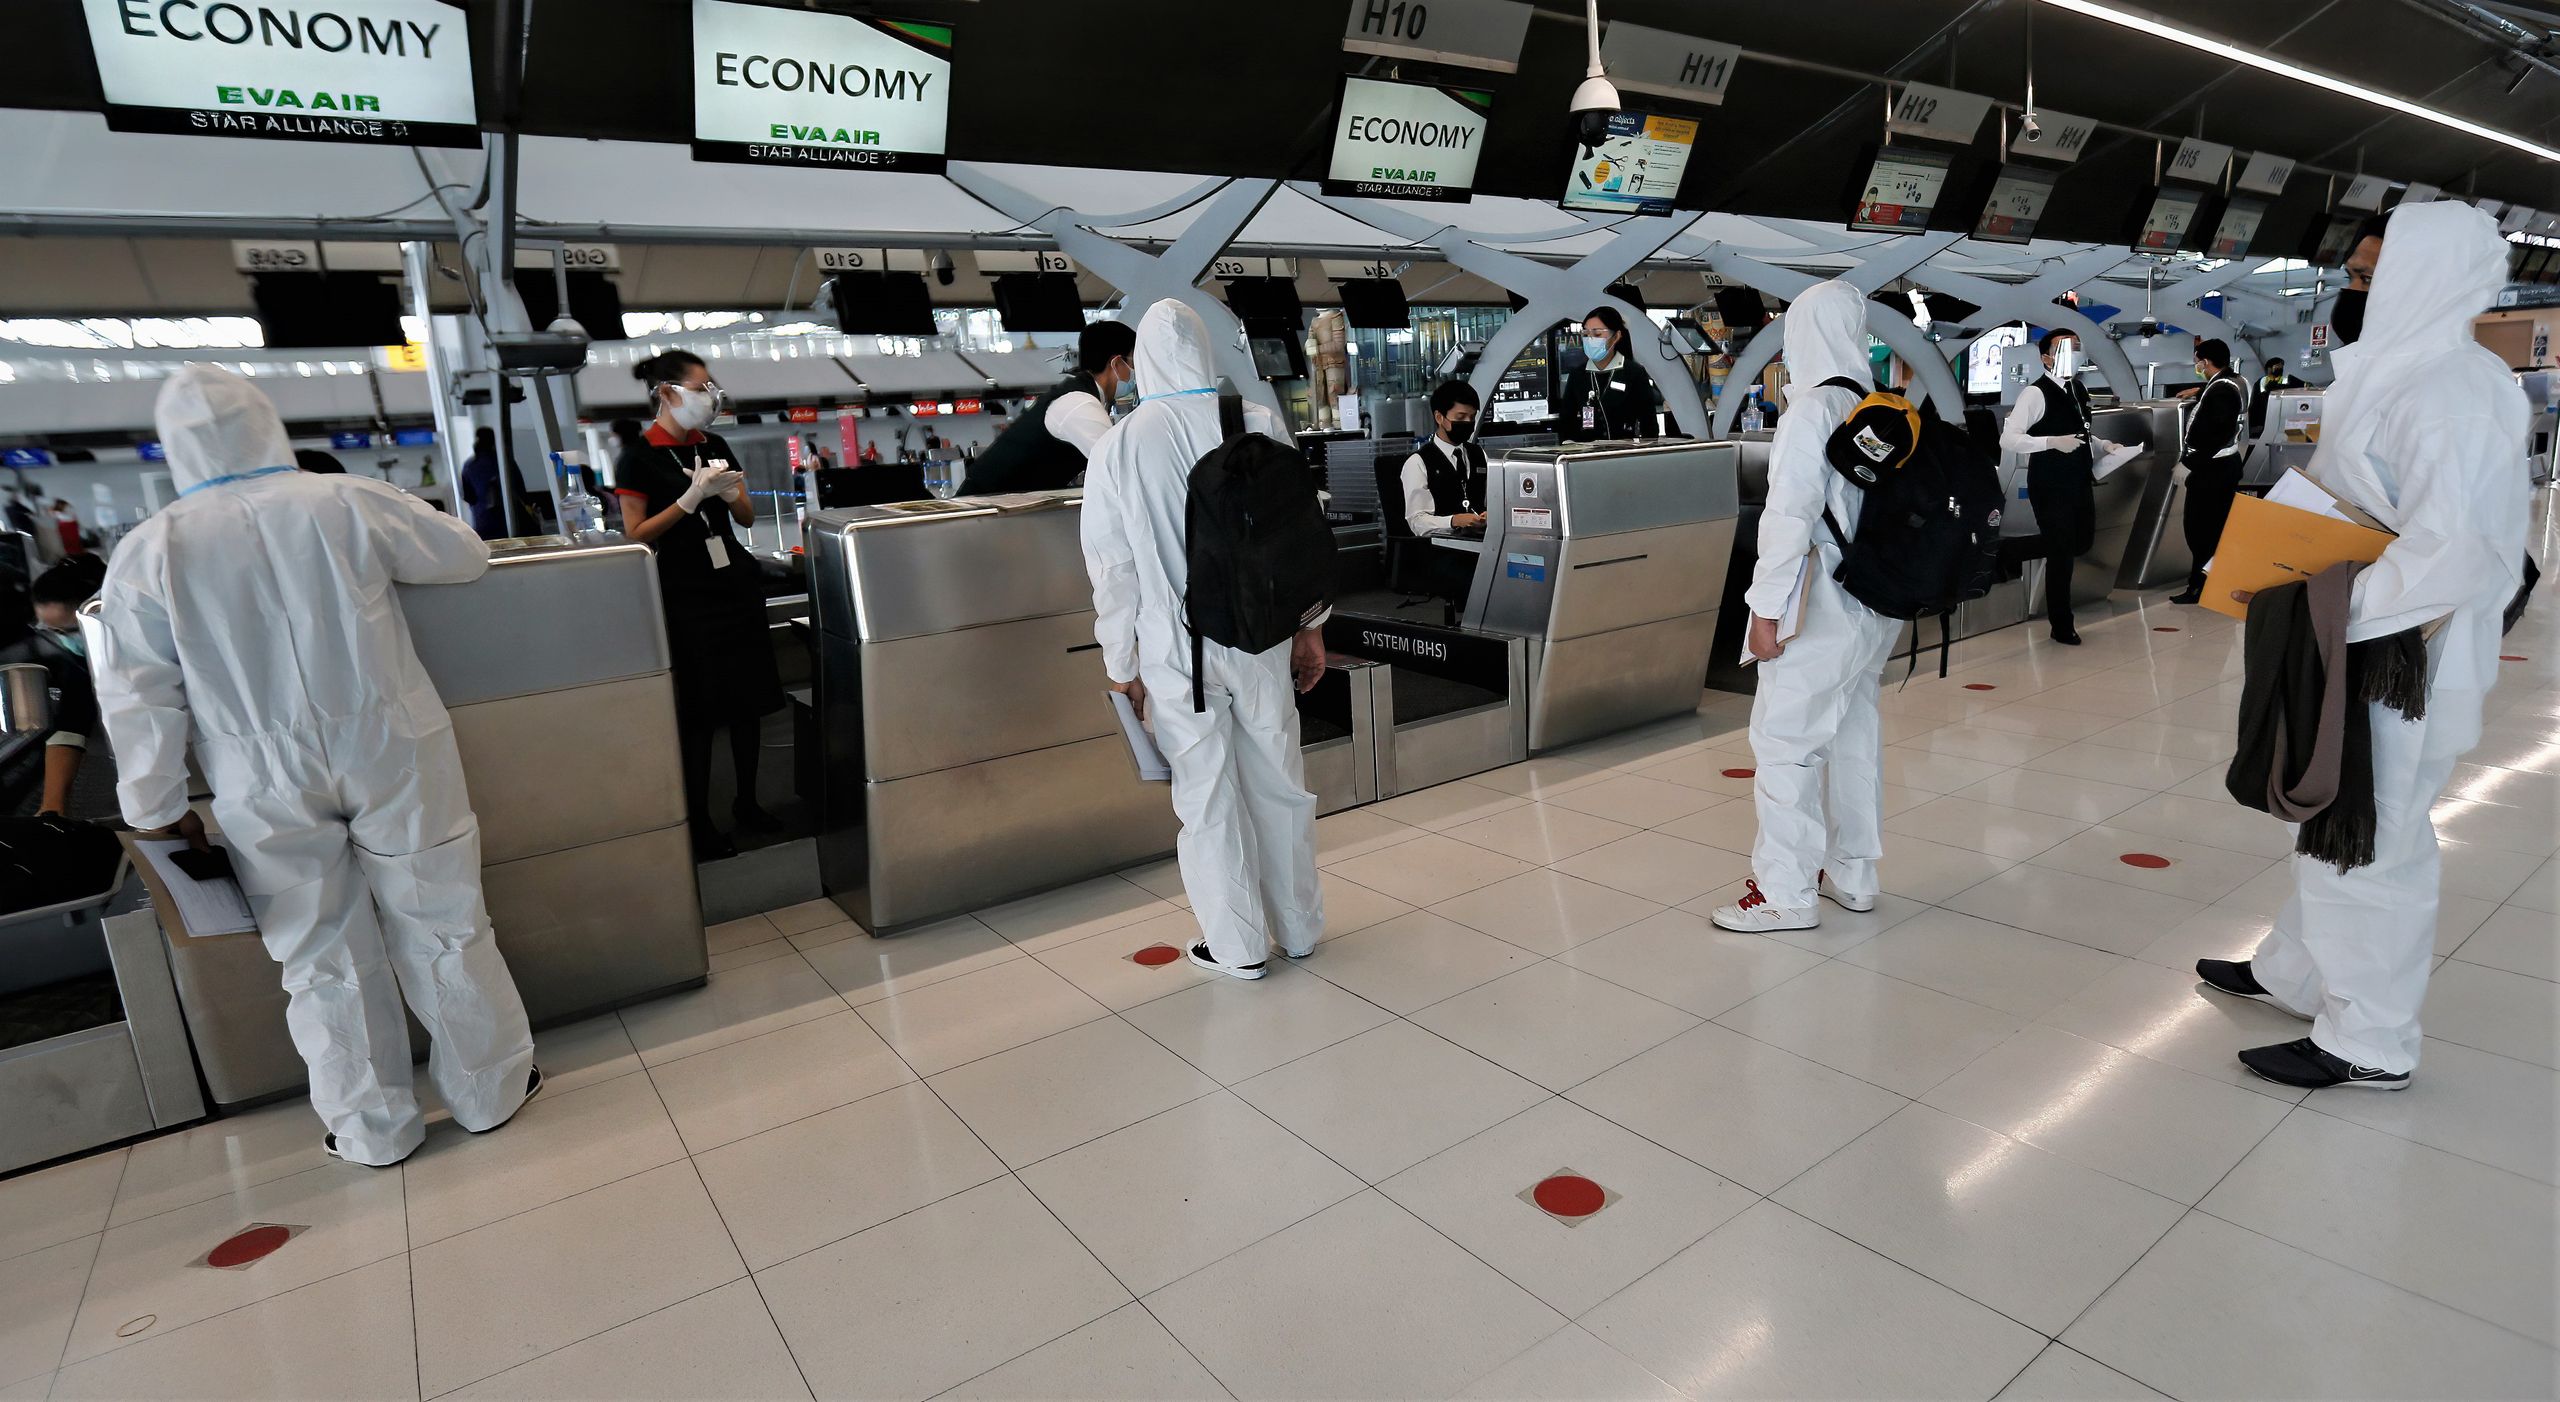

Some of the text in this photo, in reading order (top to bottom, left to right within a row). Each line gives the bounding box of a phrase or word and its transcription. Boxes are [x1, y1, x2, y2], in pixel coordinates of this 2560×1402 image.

[117, 0, 440, 58] ECONOMY
[1361, 0, 1427, 40] H10
[716, 52, 933, 102] ECONOMY
[1679, 52, 1728, 88] H11
[190, 111, 383, 137] STAR ALLIANCE
[1899, 94, 1938, 124] H12
[1348, 115, 1476, 150] ECONOMY
[2055, 126, 2087, 150] H14
[748, 143, 879, 164] STAR ALLIANCE
[2176, 147, 2201, 170] H15
[1356, 183, 1438, 197] STAR ALLIANCE
[1362, 630, 1447, 662] SYSTEM (BHS)
